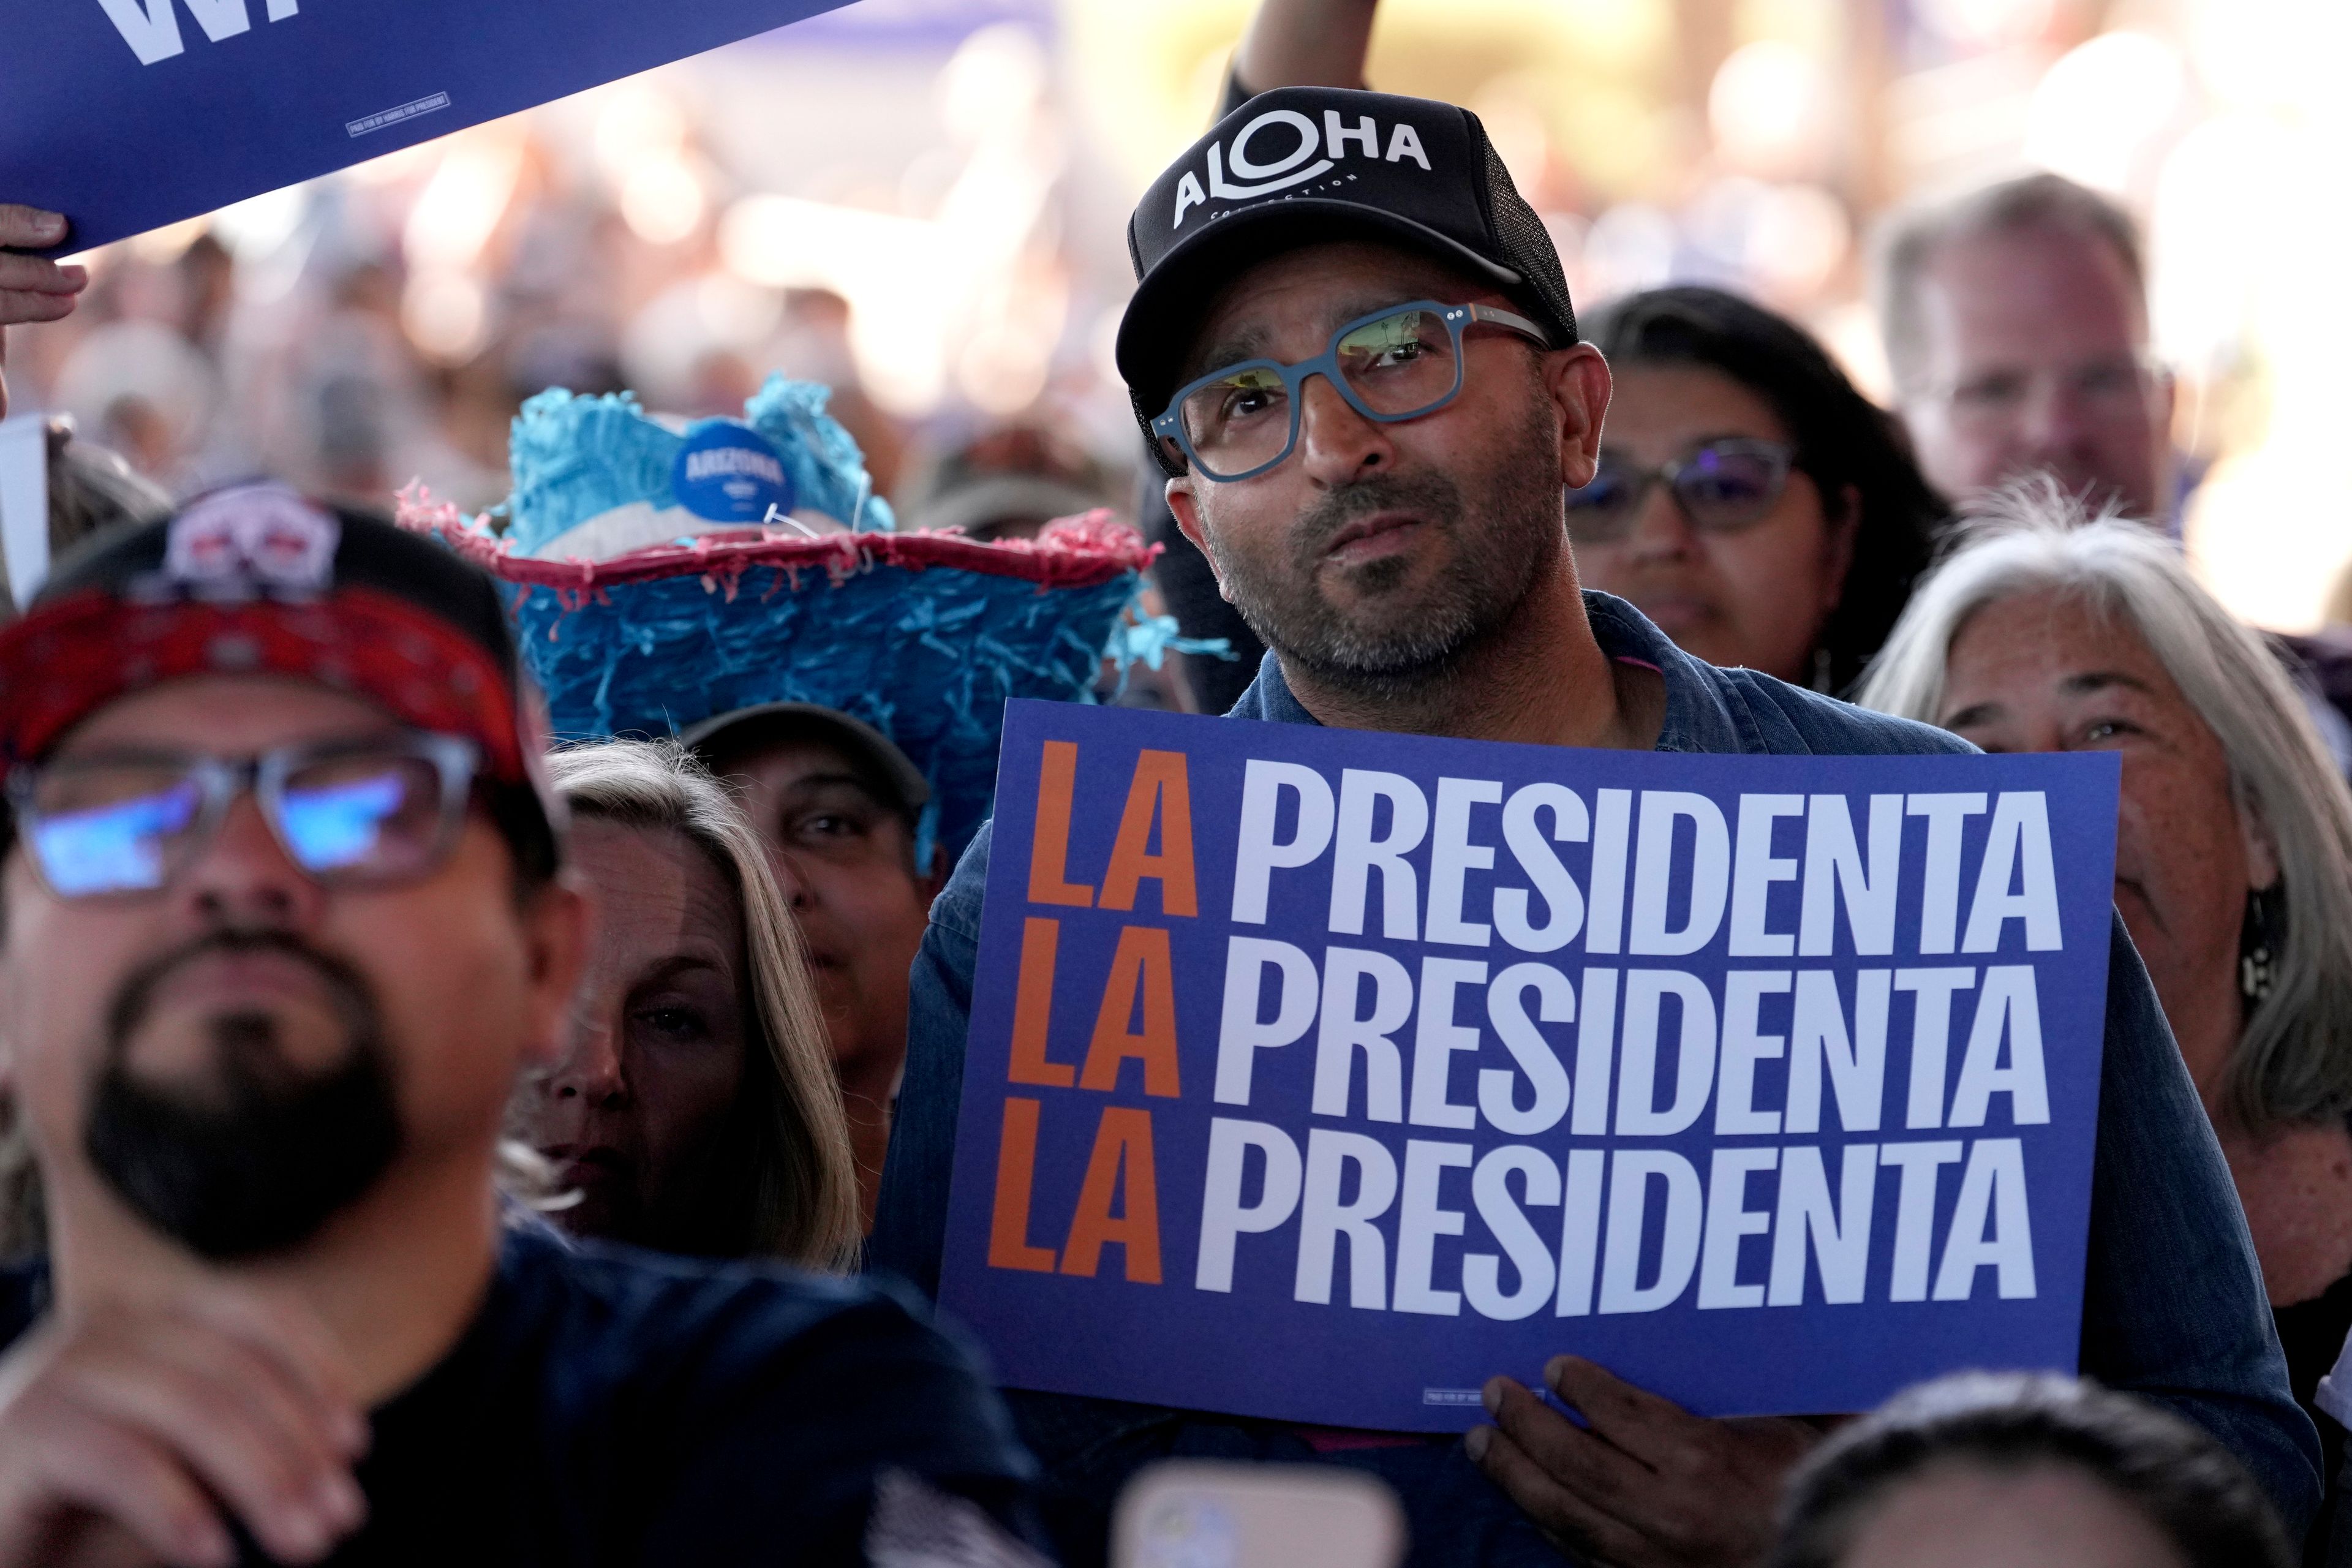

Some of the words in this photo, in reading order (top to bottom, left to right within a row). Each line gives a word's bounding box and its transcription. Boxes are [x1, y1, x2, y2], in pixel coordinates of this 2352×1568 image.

[1174, 110, 1431, 230] ALOHA
[1029, 742, 1196, 916] LA
[1231, 759, 2062, 956] PRESIDENTA
[1008, 919, 1180, 1097] LA
[1214, 936, 2049, 1136] PRESIDENTA
[987, 1098, 1162, 1284] LA
[1196, 1118, 2037, 1321] PRESIDENTA
